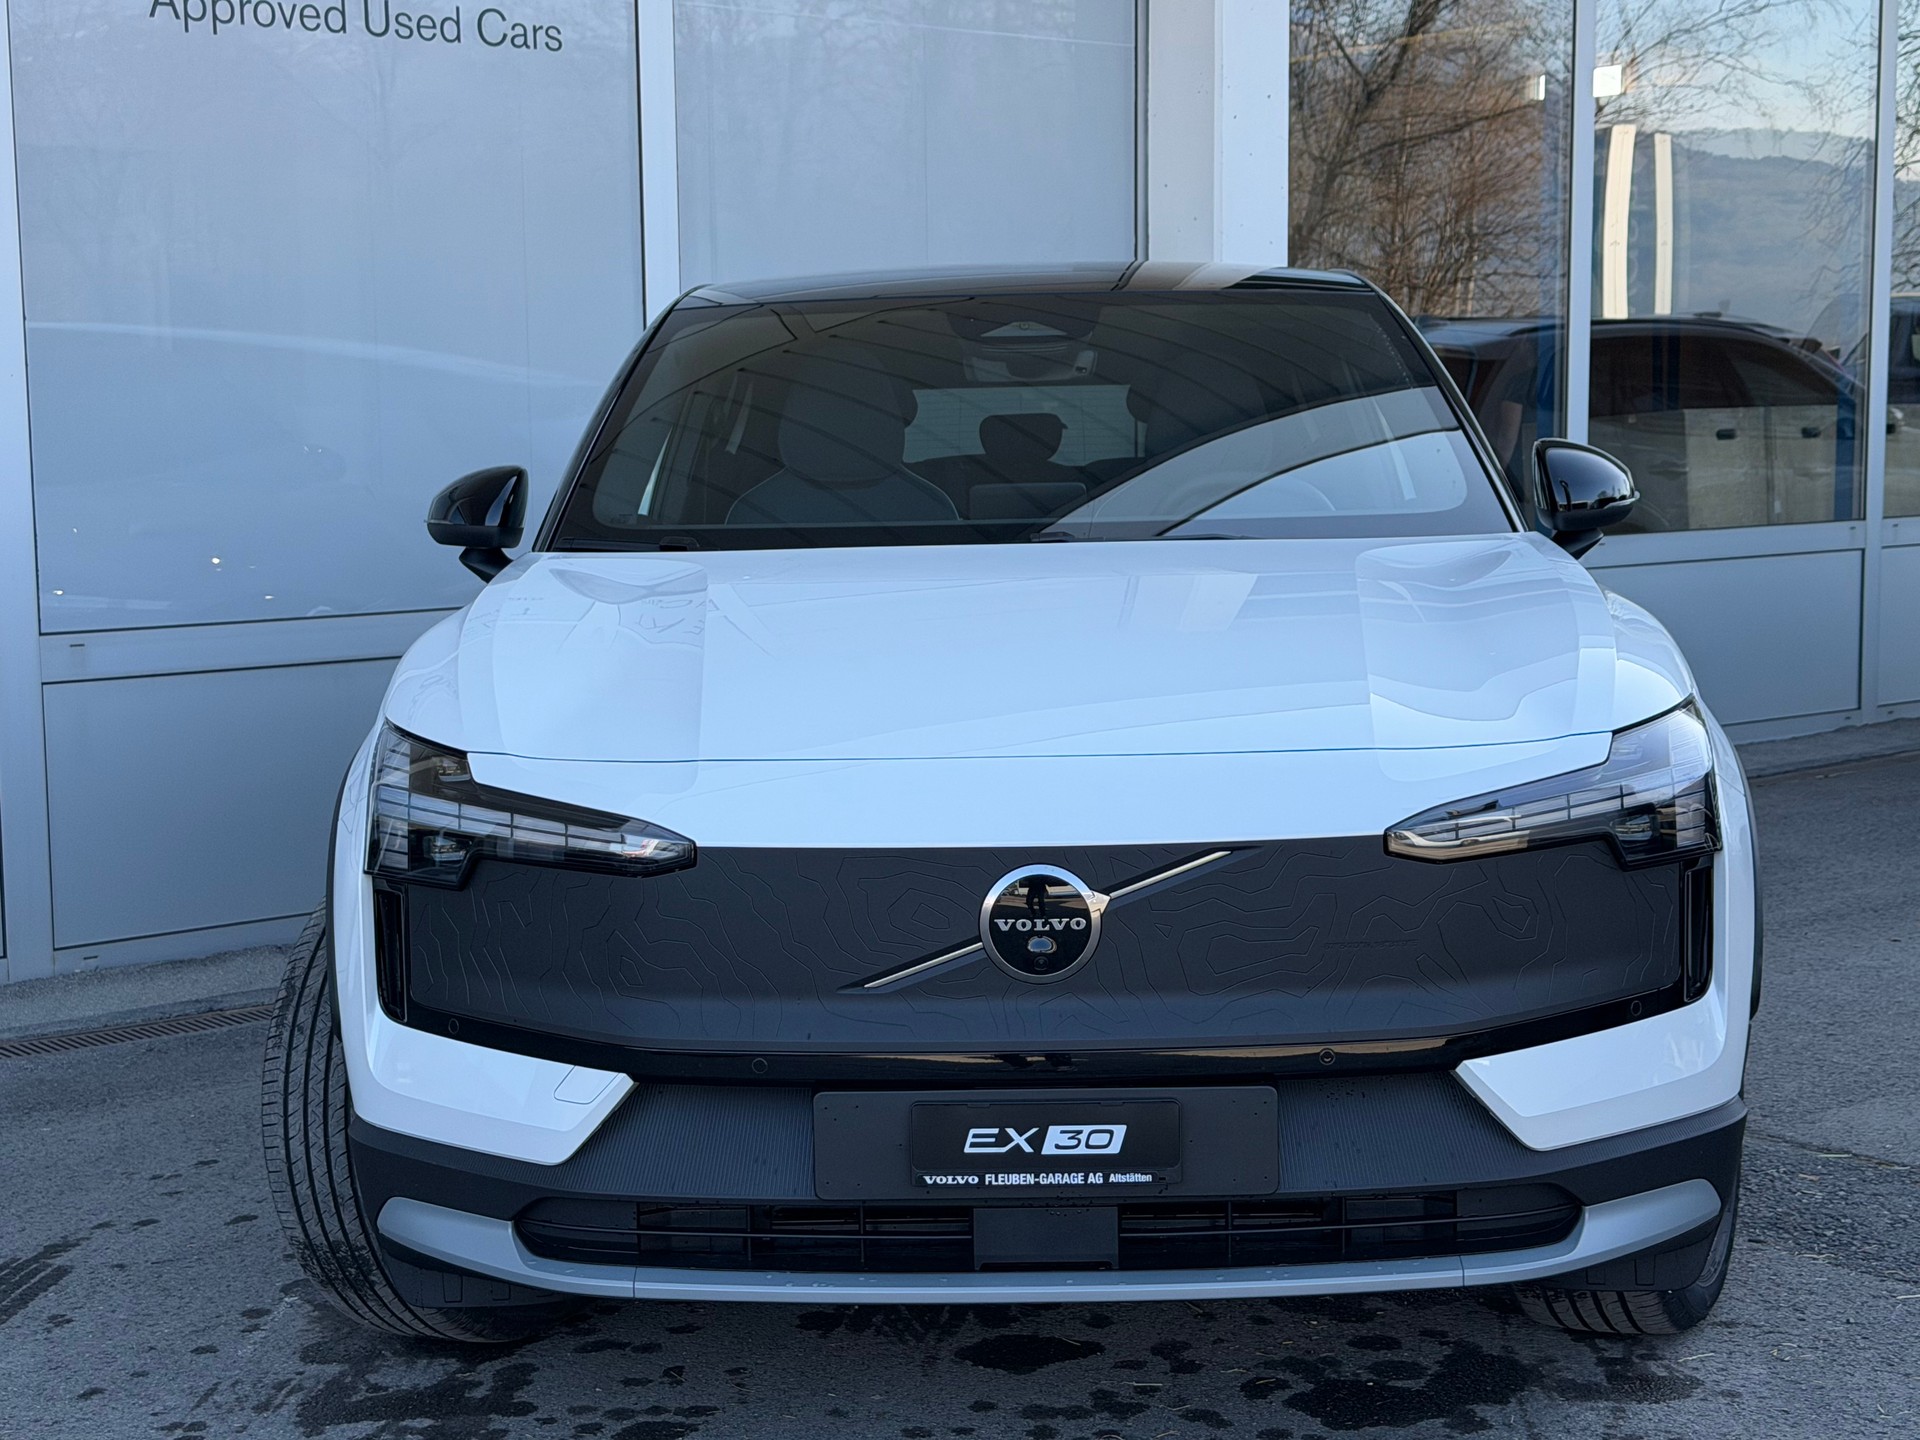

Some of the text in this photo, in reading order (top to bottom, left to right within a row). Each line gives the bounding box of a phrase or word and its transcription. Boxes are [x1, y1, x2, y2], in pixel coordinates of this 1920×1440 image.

[363, 0, 462, 44] Used
[477, 8, 563, 52] Cars
[994, 917, 1087, 932] VOLVO
[923, 1172, 1152, 1185] VOLVO FLEUBEN-GARAGE AG Altstätten
